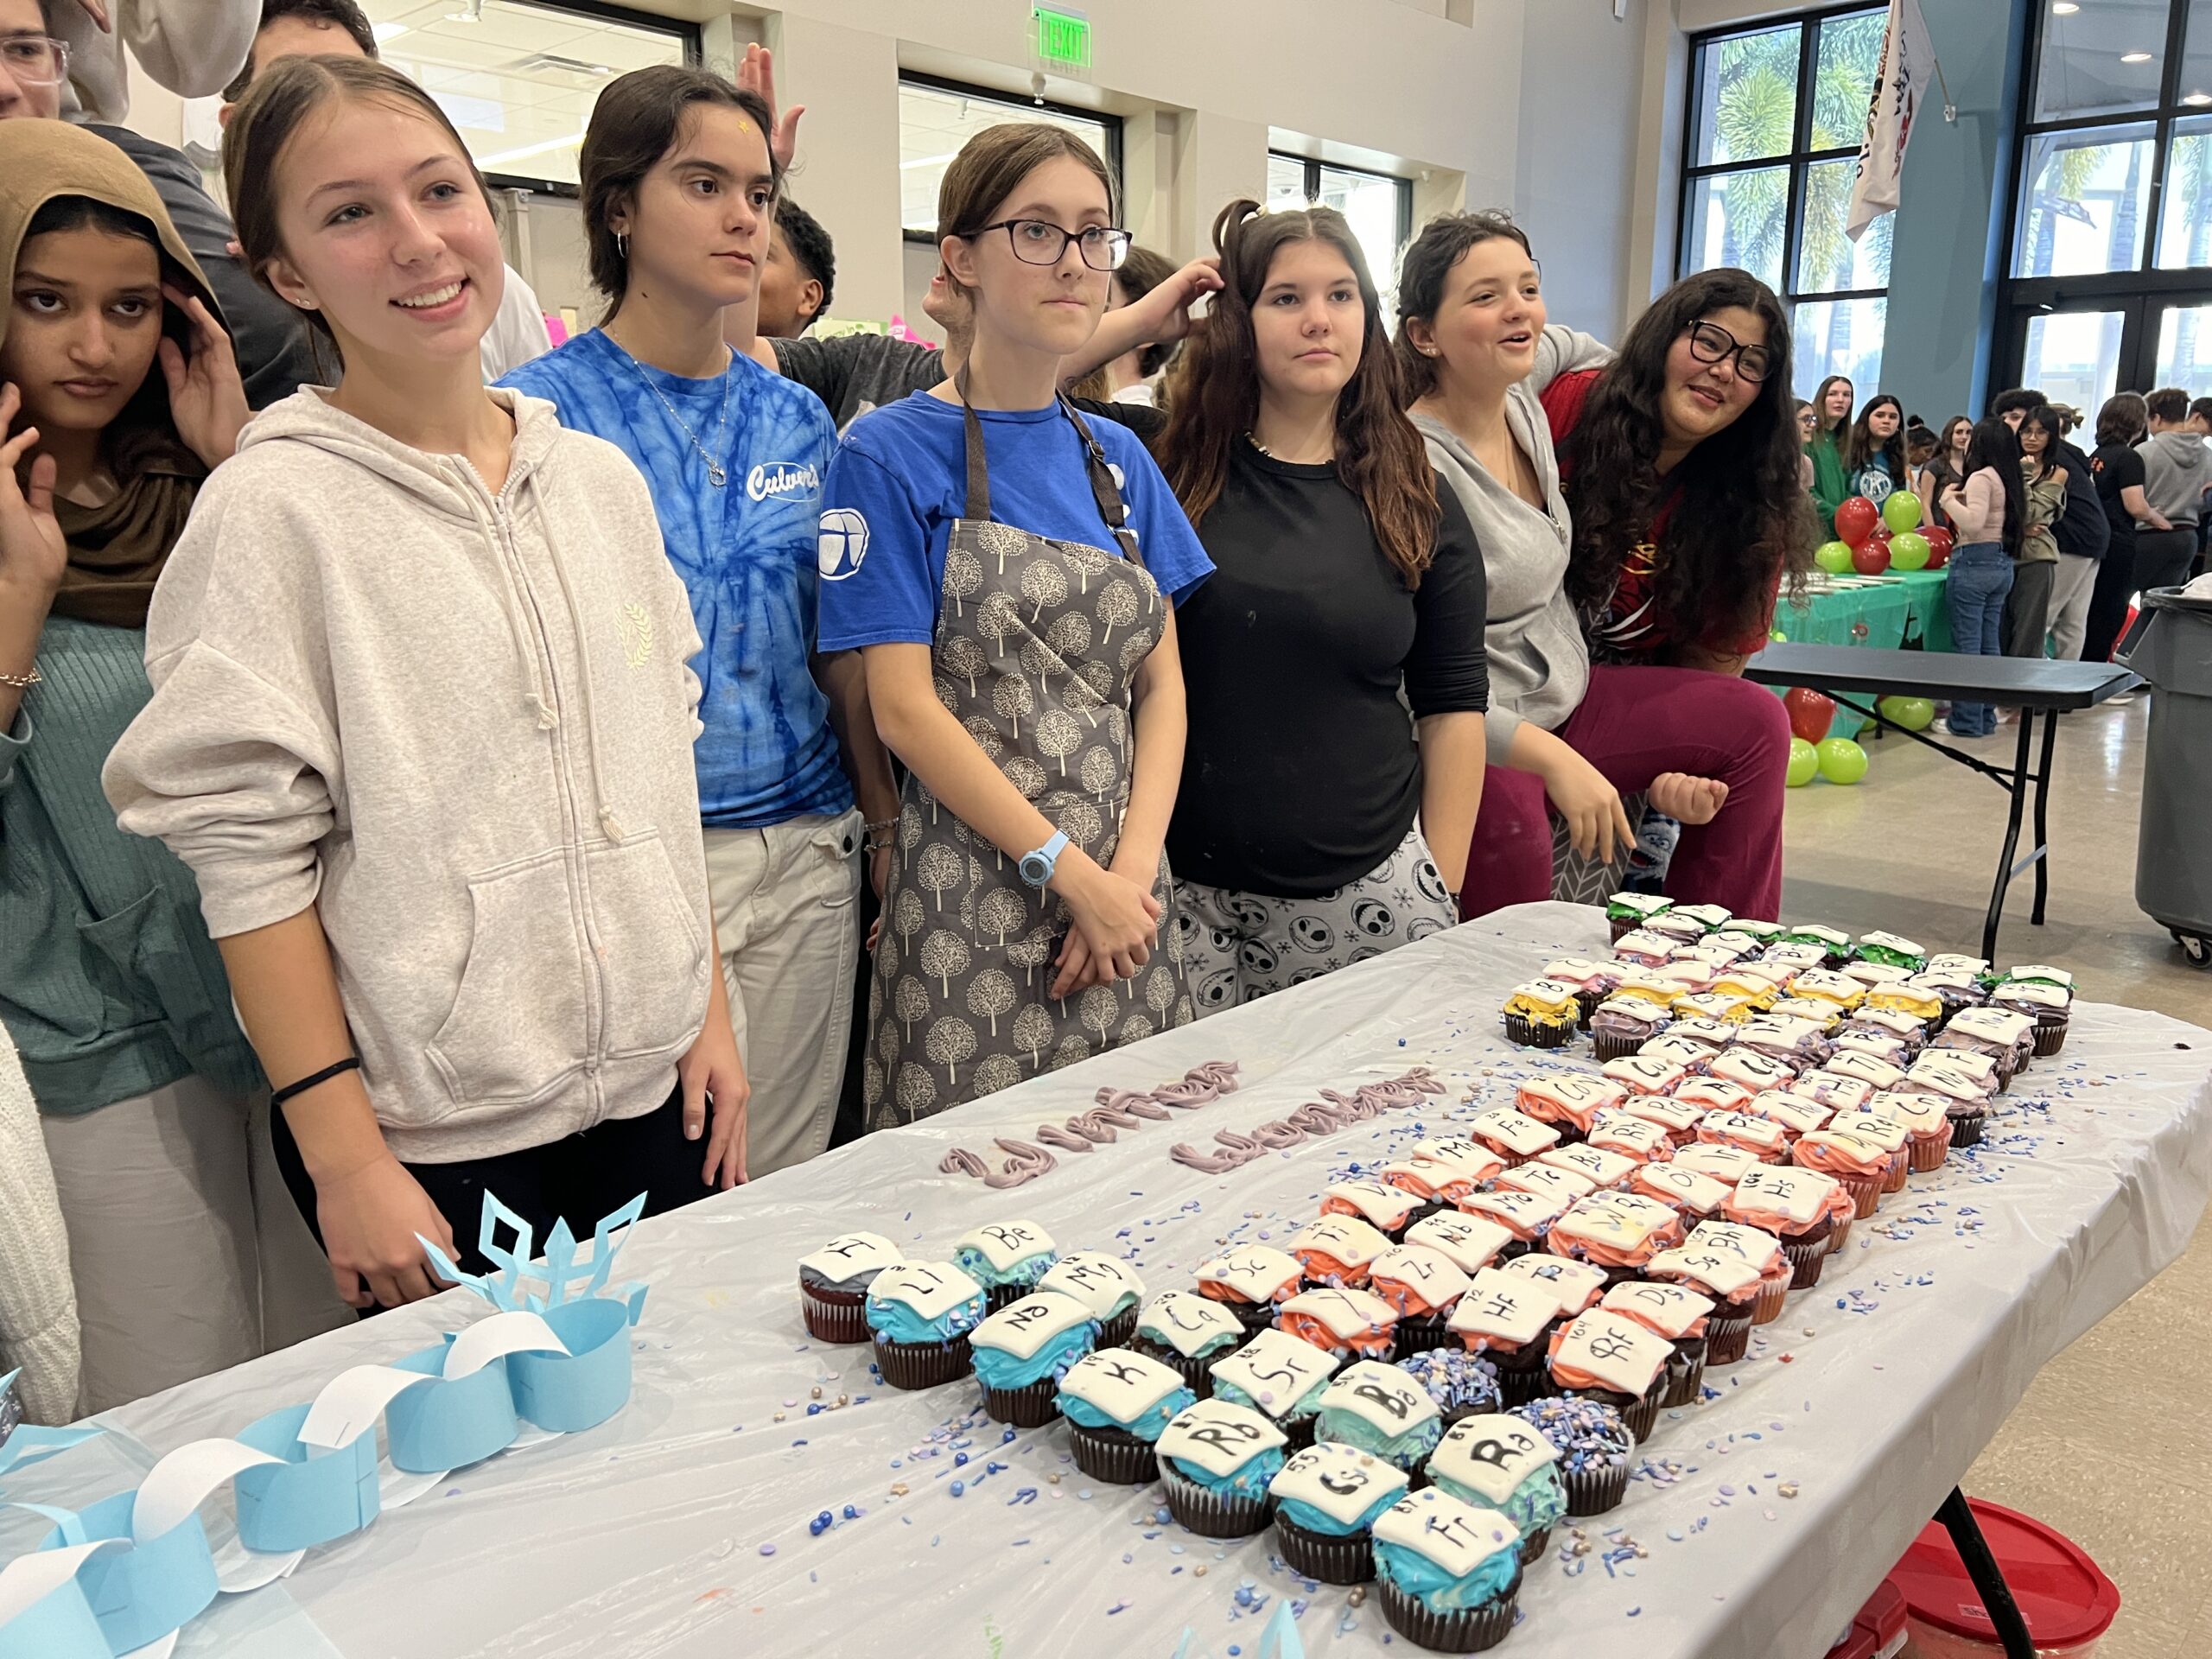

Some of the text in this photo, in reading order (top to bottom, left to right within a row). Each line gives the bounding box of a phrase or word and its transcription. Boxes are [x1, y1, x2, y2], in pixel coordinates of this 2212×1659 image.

[1049, 19, 1083, 60] EXIT
[1554, 1082, 1591, 1101] Co
[1895, 1096, 1936, 1116] Cn
[1497, 1119, 1531, 1138] Fe
[1611, 1122, 1649, 1141] Rh
[1440, 1141, 1481, 1160] Mn
[1763, 1179, 1796, 1199] Hs
[981, 1225, 1034, 1251] Be
[1228, 1258, 1267, 1278] Sc
[1400, 1259, 1437, 1281] Zr
[1684, 1255, 1721, 1272] Sg
[1065, 1262, 1123, 1293] Mg
[1464, 1287, 1484, 1303] 72
[1003, 1305, 1049, 1332] Na
[1165, 1305, 1221, 1332] Ca
[1568, 1319, 1593, 1341] 104
[1082, 1354, 1105, 1368] 19
[1103, 1360, 1147, 1386] K
[1248, 1357, 1311, 1393] Sr
[1352, 1383, 1419, 1421] Ba
[1187, 1419, 1262, 1458] Rb
[1287, 1452, 1320, 1474] 55
[1470, 1433, 1535, 1473] Ra
[1319, 1470, 1370, 1497] Cs
